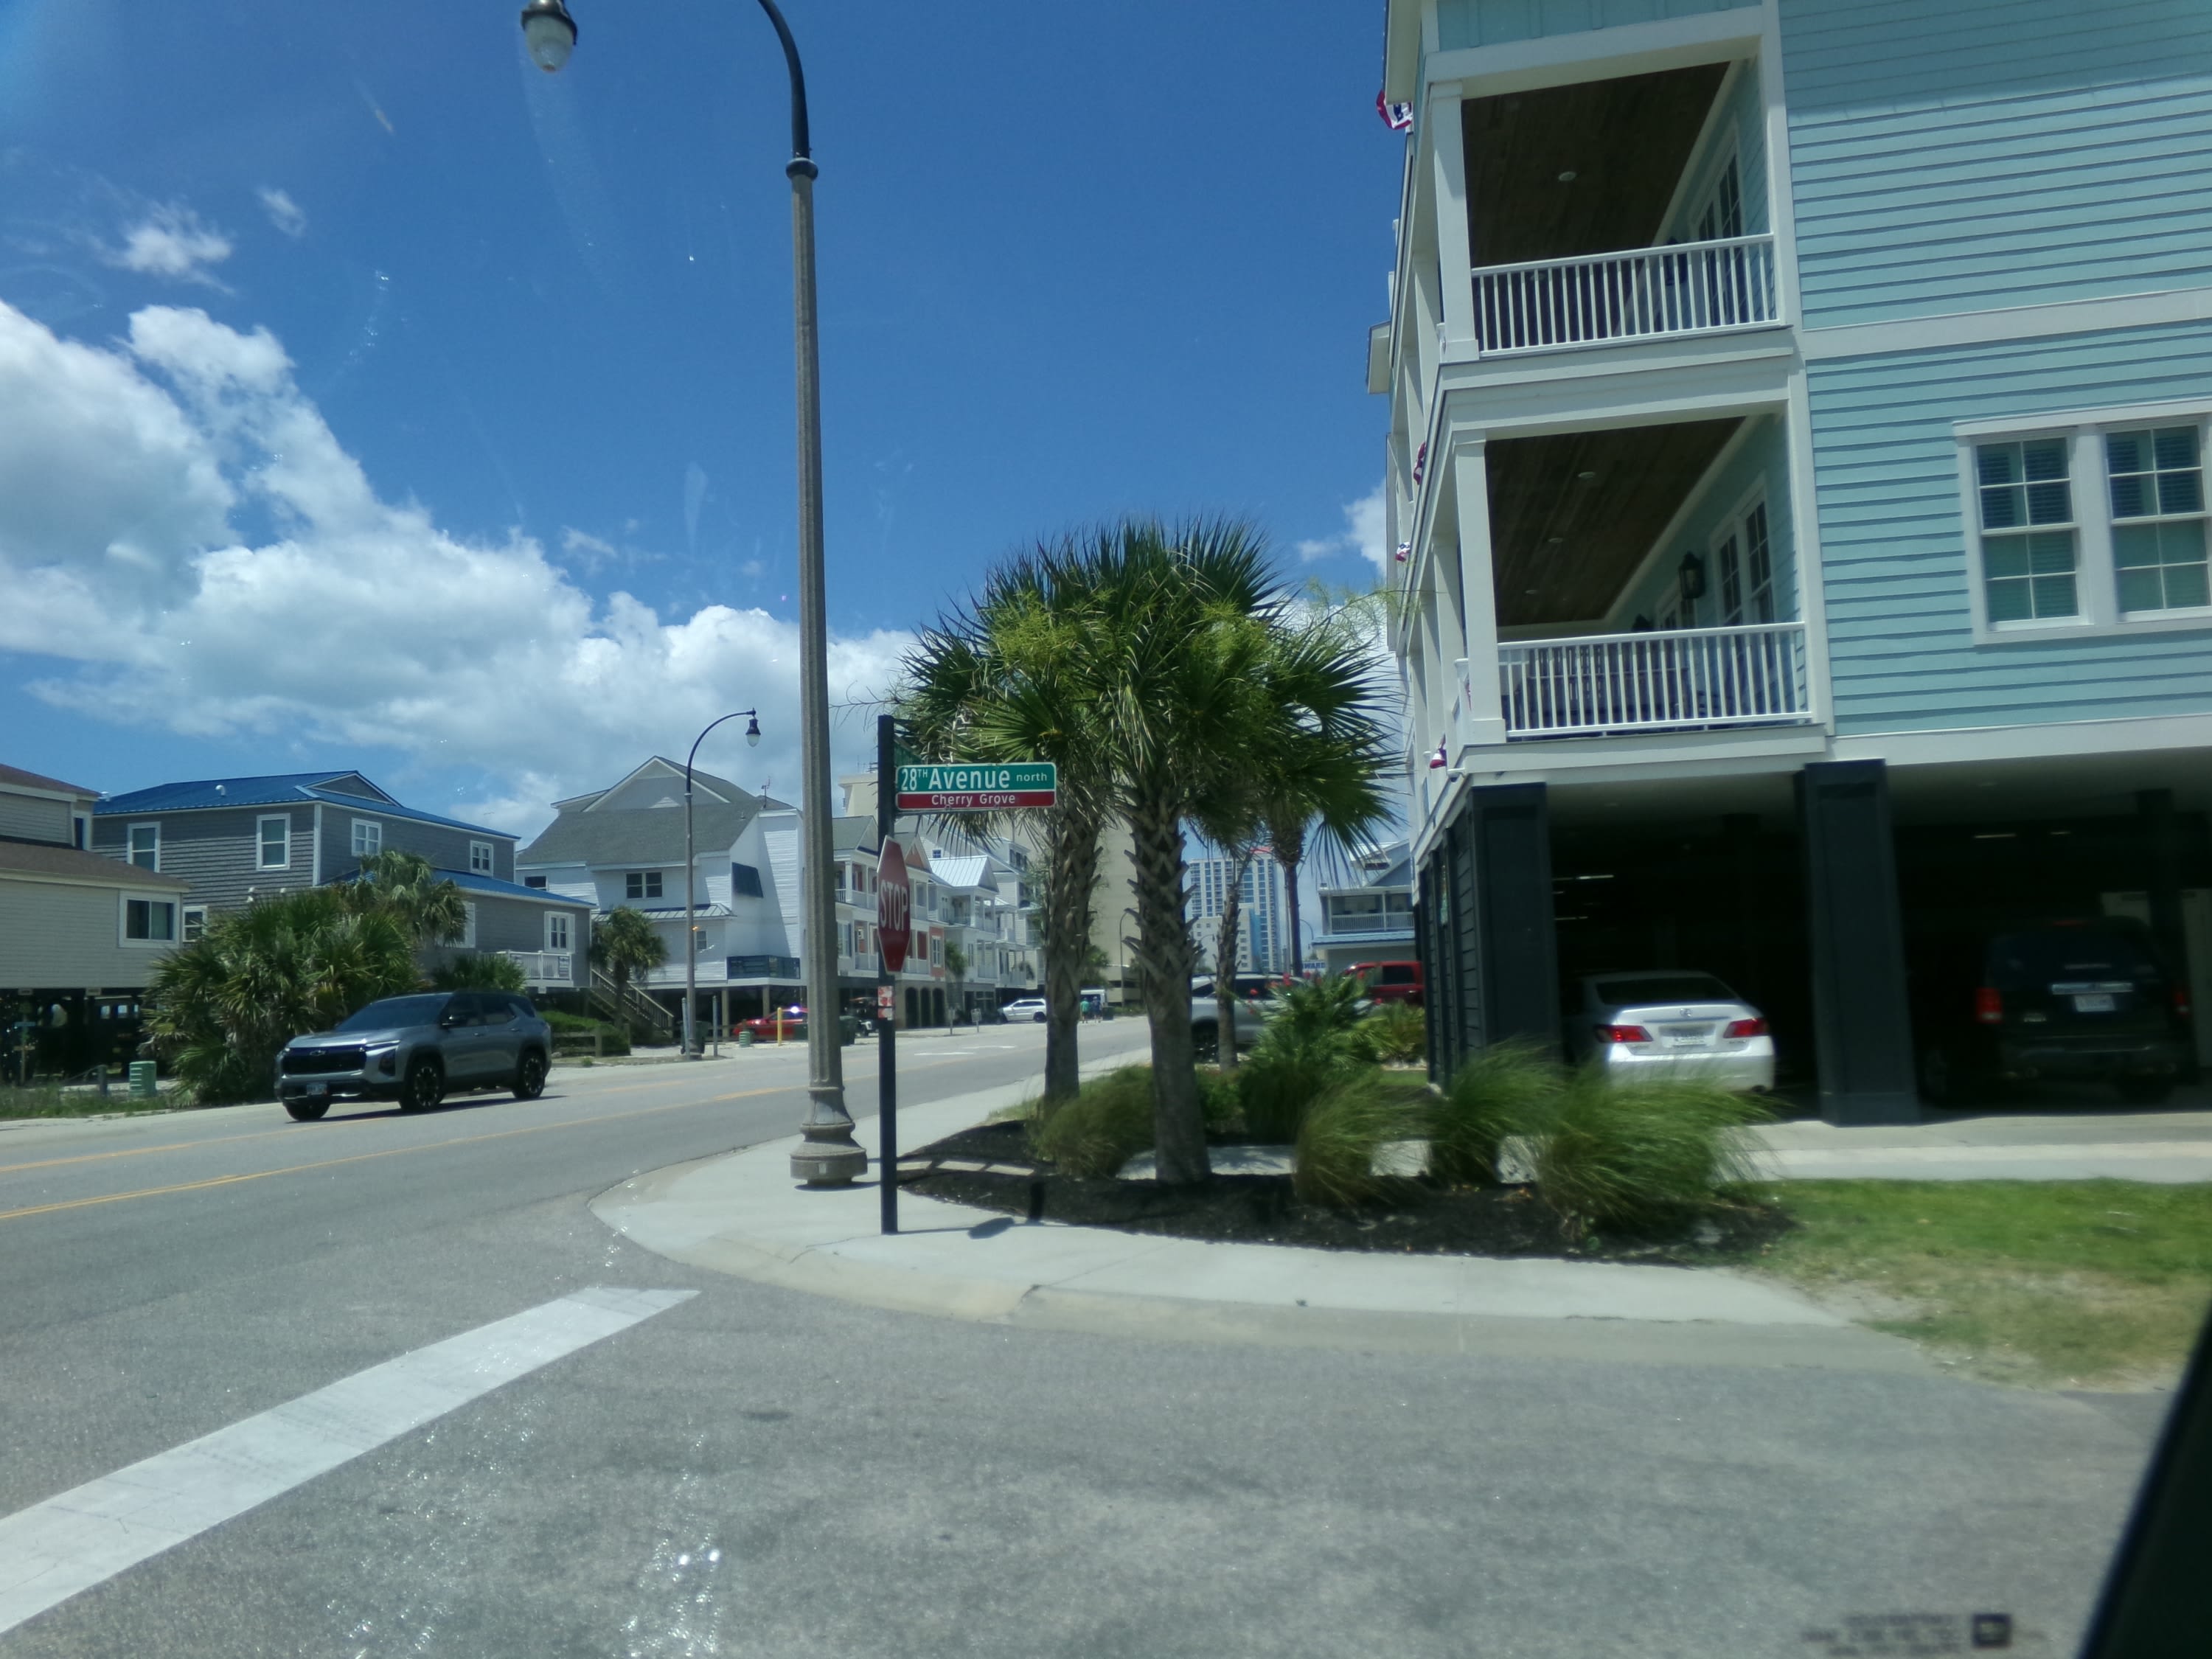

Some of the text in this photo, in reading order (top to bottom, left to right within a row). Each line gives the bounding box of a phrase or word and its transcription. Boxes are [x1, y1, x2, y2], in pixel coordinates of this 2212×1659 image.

[901, 768, 1048, 791] 28TH Avenue north
[931, 793, 1015, 807] Cherry Grove
[880, 880, 908, 931] STOP
